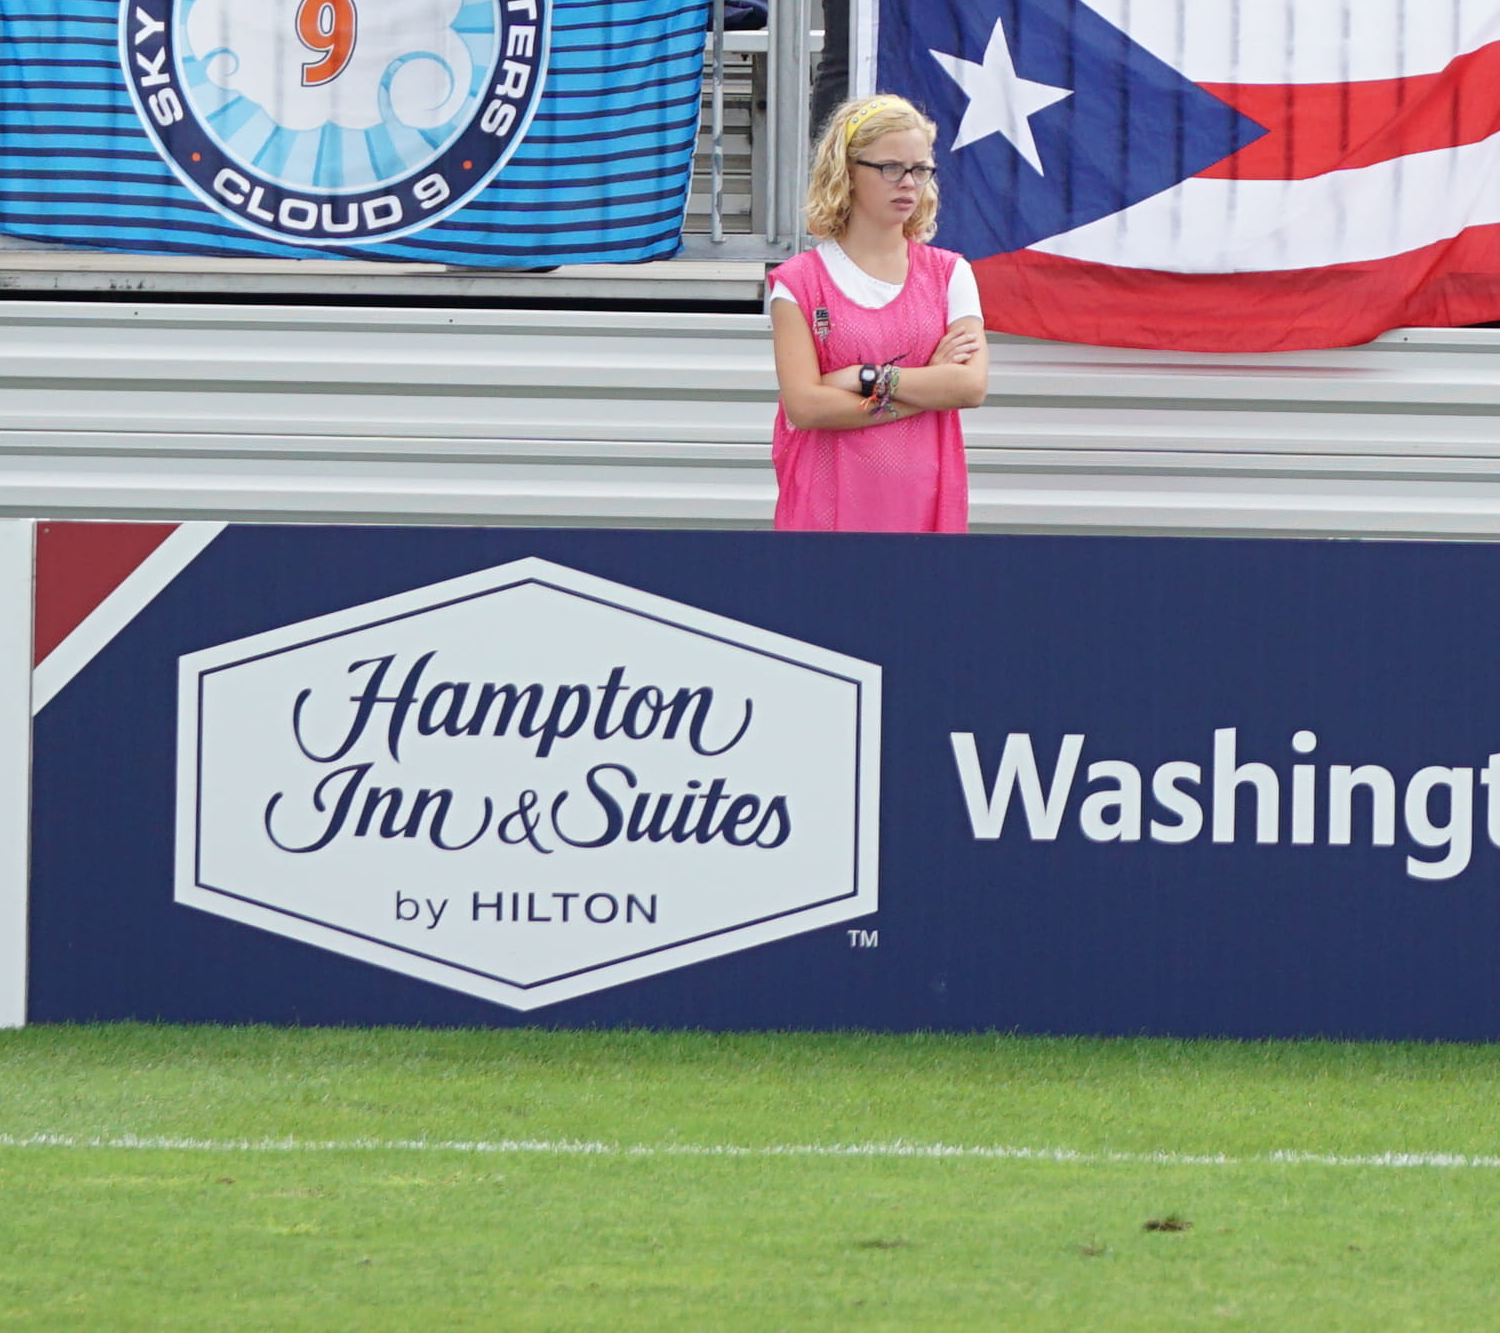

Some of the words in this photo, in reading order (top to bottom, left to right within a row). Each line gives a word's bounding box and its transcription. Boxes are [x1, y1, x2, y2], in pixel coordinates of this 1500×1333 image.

[134, 6, 184, 127] SKY
[213, 167, 403, 233] CLOUD
[412, 173, 451, 210] 9
[292, 650, 753, 764] Hampton
[264, 762, 494, 854] Inn
[498, 788, 555, 855] &
[550, 762, 792, 849] Suites
[396, 890, 449, 928] by
[471, 892, 658, 924] HILTON
